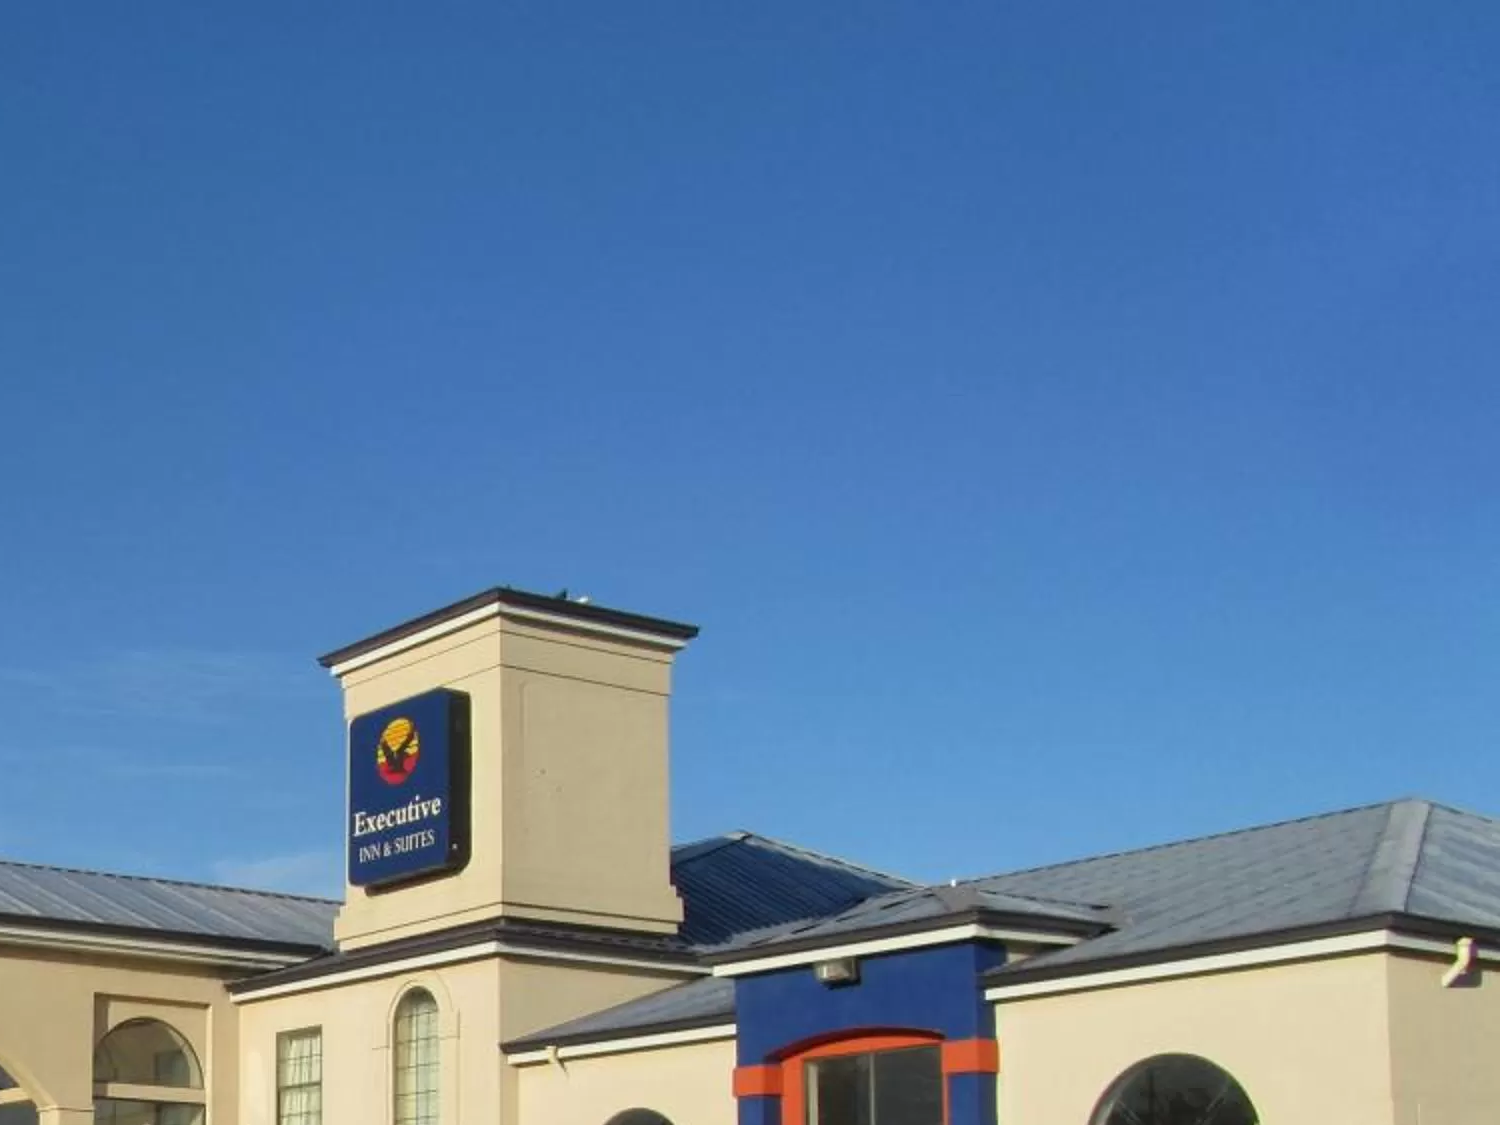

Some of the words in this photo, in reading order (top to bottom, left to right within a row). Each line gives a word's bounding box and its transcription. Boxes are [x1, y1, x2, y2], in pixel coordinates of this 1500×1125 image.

[352, 794, 442, 837] Executive
[359, 842, 381, 864] INN
[383, 842, 392, 857] &
[394, 829, 435, 854] SUITES
